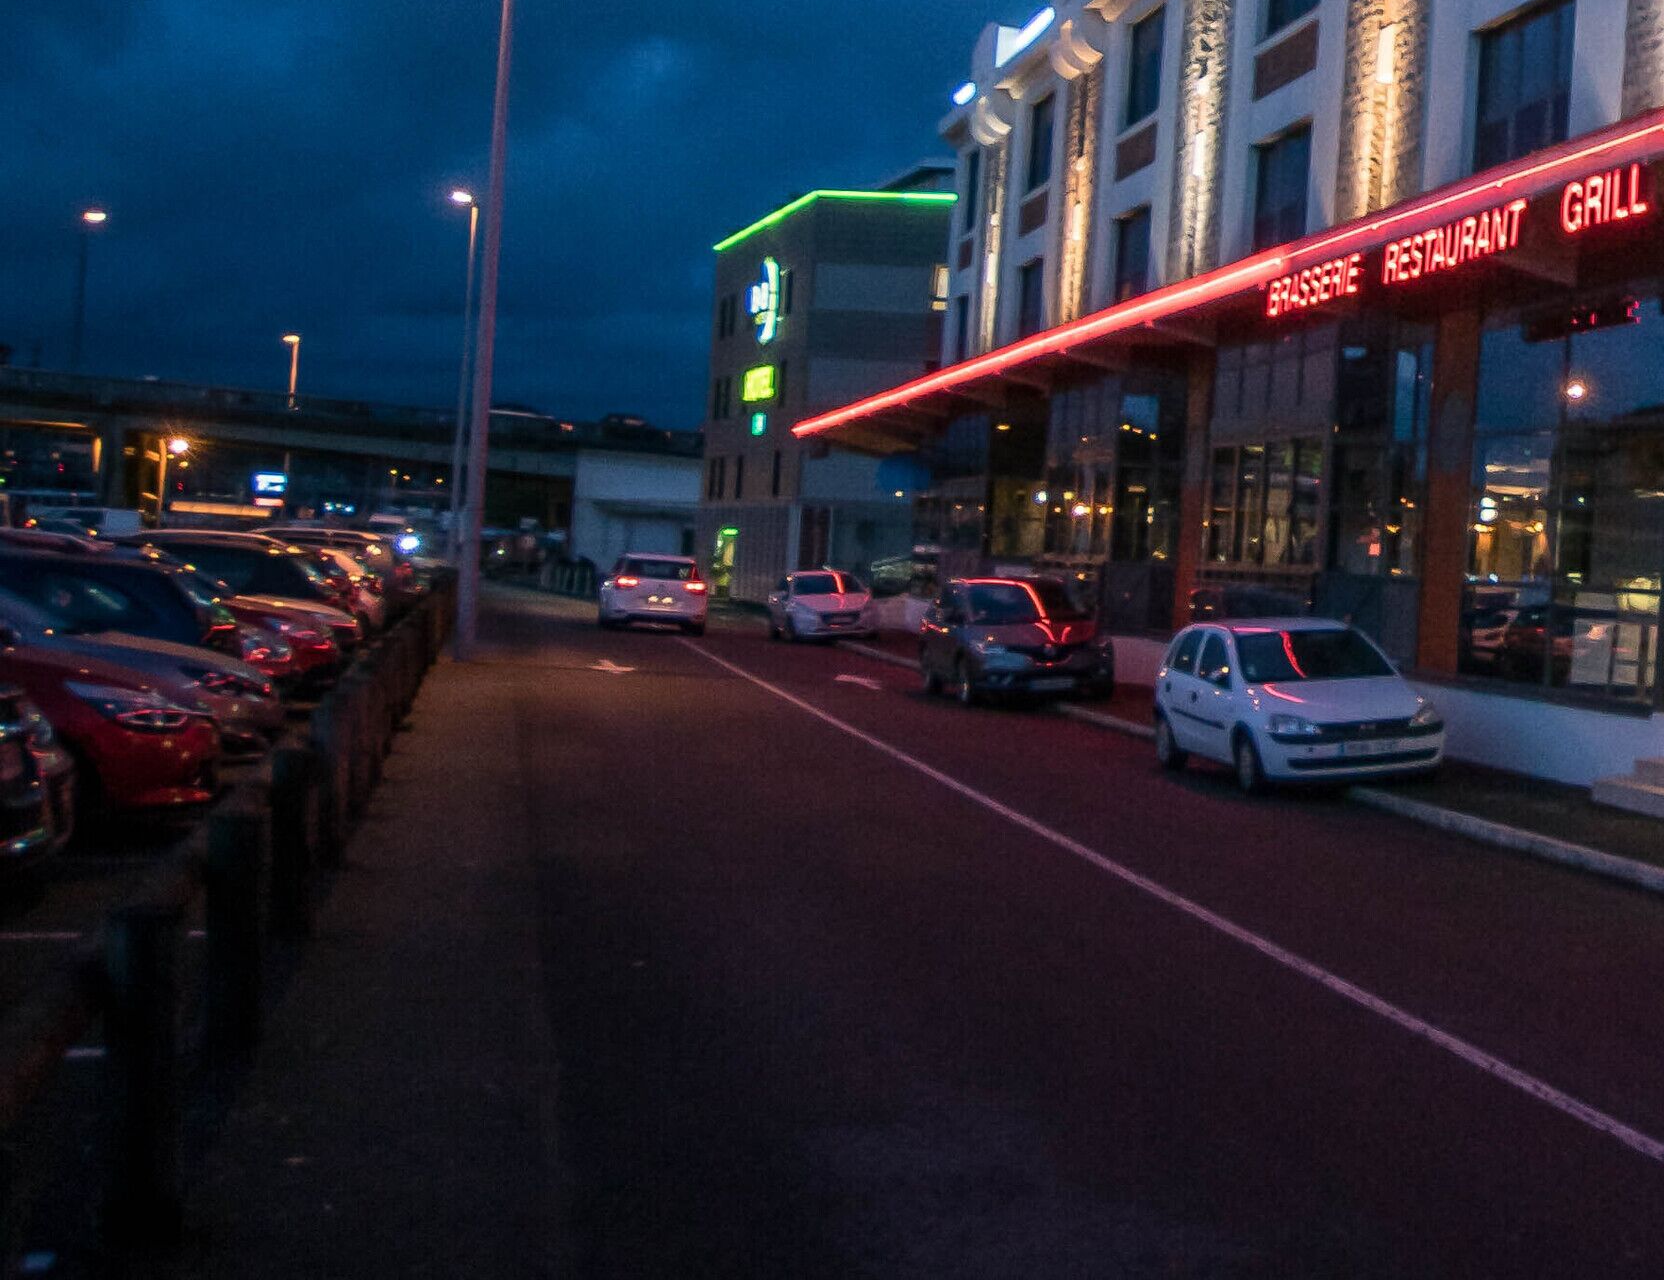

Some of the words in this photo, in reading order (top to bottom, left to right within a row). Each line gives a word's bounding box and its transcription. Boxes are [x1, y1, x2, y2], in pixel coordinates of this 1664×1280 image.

[1266, 252, 1365, 316] BRASSERIE
[1382, 198, 1529, 285] RESTAURANT
[1560, 162, 1649, 234] GRILL
